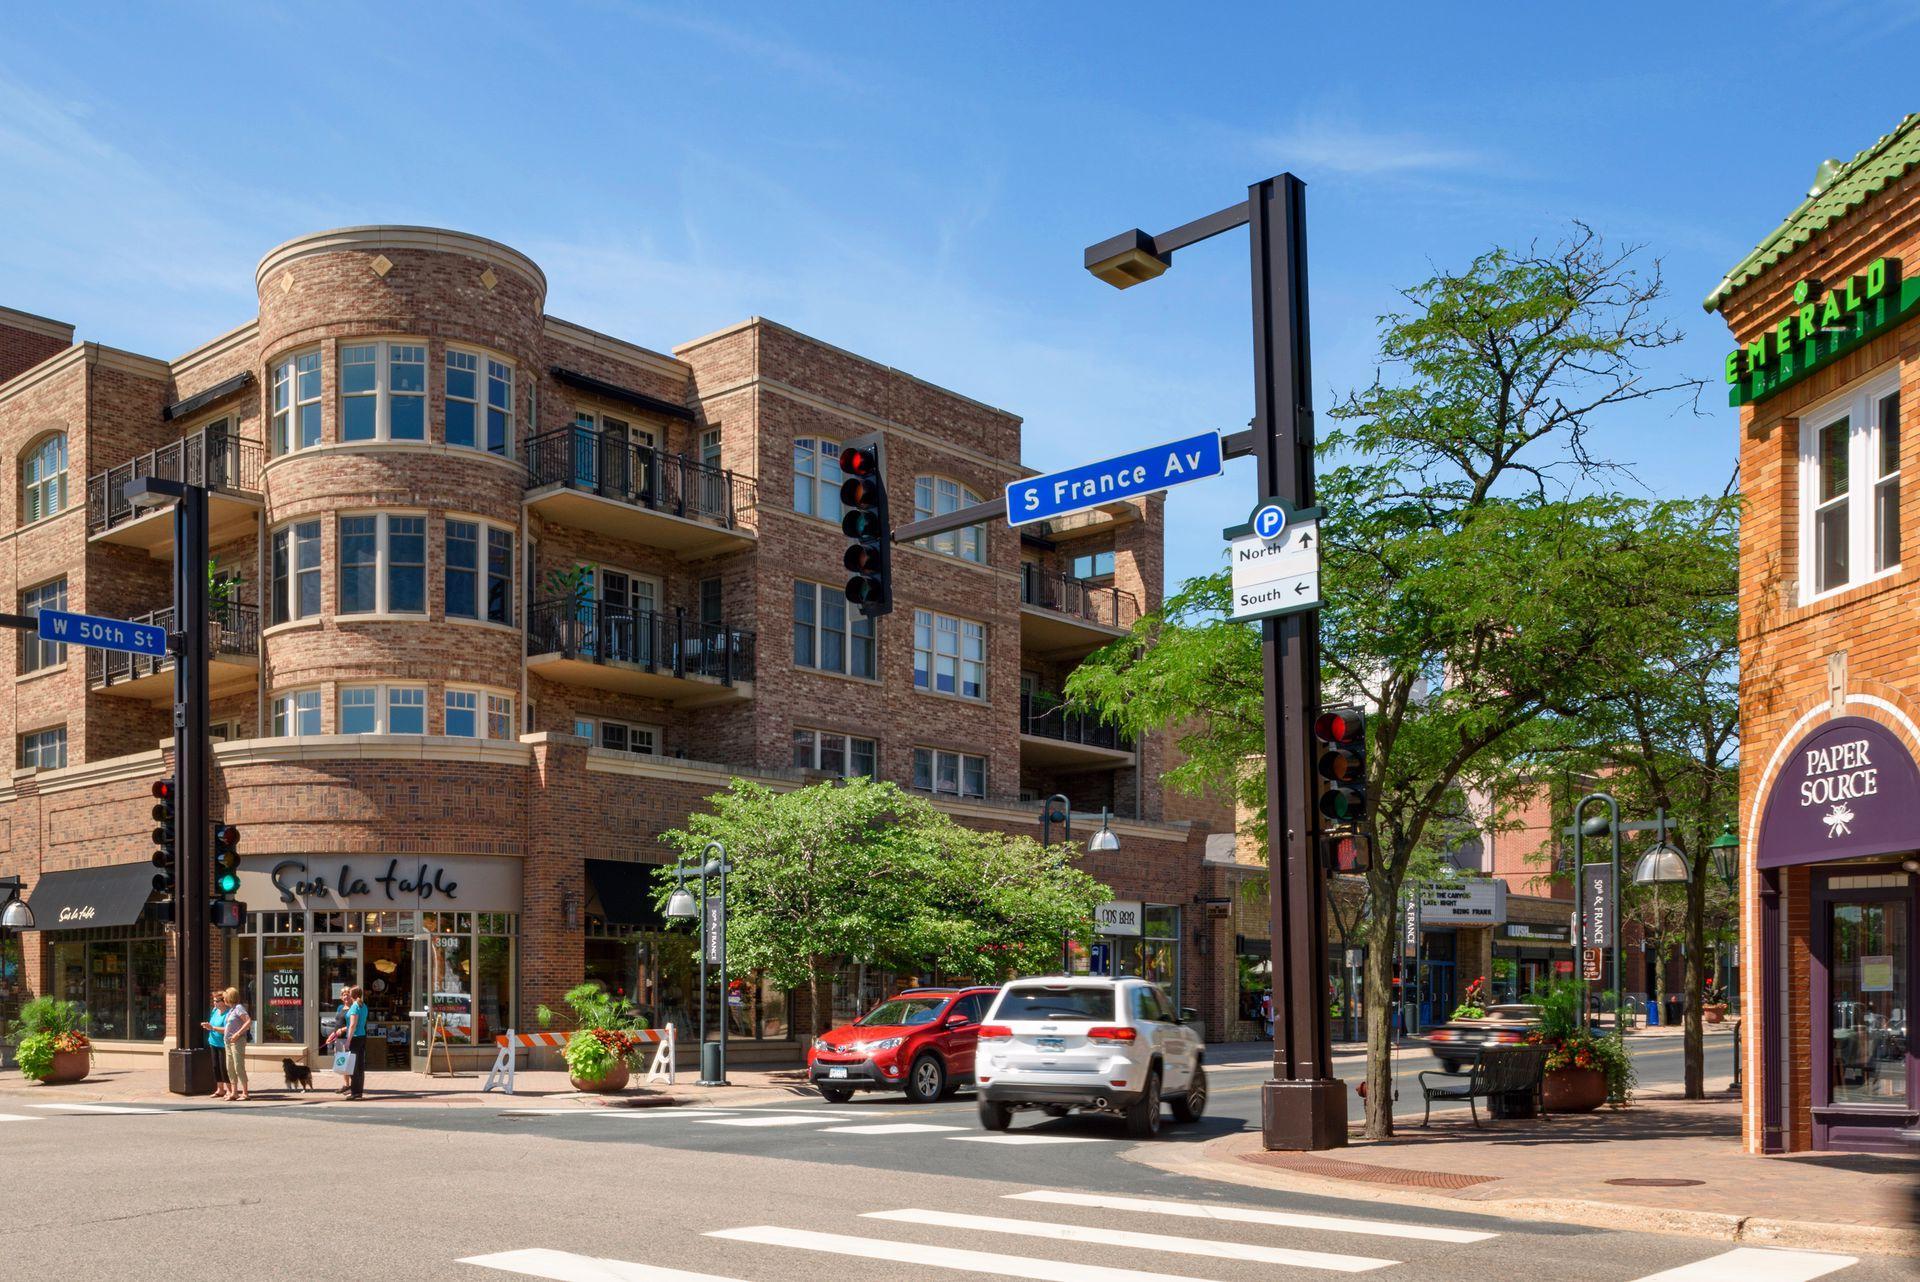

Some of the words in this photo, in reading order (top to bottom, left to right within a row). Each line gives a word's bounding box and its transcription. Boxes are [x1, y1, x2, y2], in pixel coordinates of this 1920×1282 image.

[1725, 257, 1886, 385] EMERALD
[1024, 488, 1040, 511] S
[1054, 465, 1146, 504] France
[1164, 451, 1201, 477] Av
[1263, 511, 1278, 533] P
[1240, 543, 1281, 562] North
[1240, 588, 1281, 606] South
[53, 618, 68, 636] W
[80, 622, 124, 643] 50th
[134, 630, 153, 648] St
[1806, 739, 1872, 776] PAPER
[1801, 768, 1877, 806] SOURCE
[271, 860, 328, 903] Sur
[338, 865, 370, 897] la
[375, 859, 458, 900] table
[1407, 902, 1415, 911] &
[1594, 896, 1604, 906] &
[1101, 909, 1117, 924] COS
[1119, 910, 1135, 925] BAR
[1594, 907, 1603, 944] FRANCE
[1407, 912, 1415, 944] FRANCE
[1508, 925, 1530, 938] LUSH
[435, 938, 458, 948] 3901
[273, 974, 299, 985] SUM
[273, 987, 299, 997] MER
